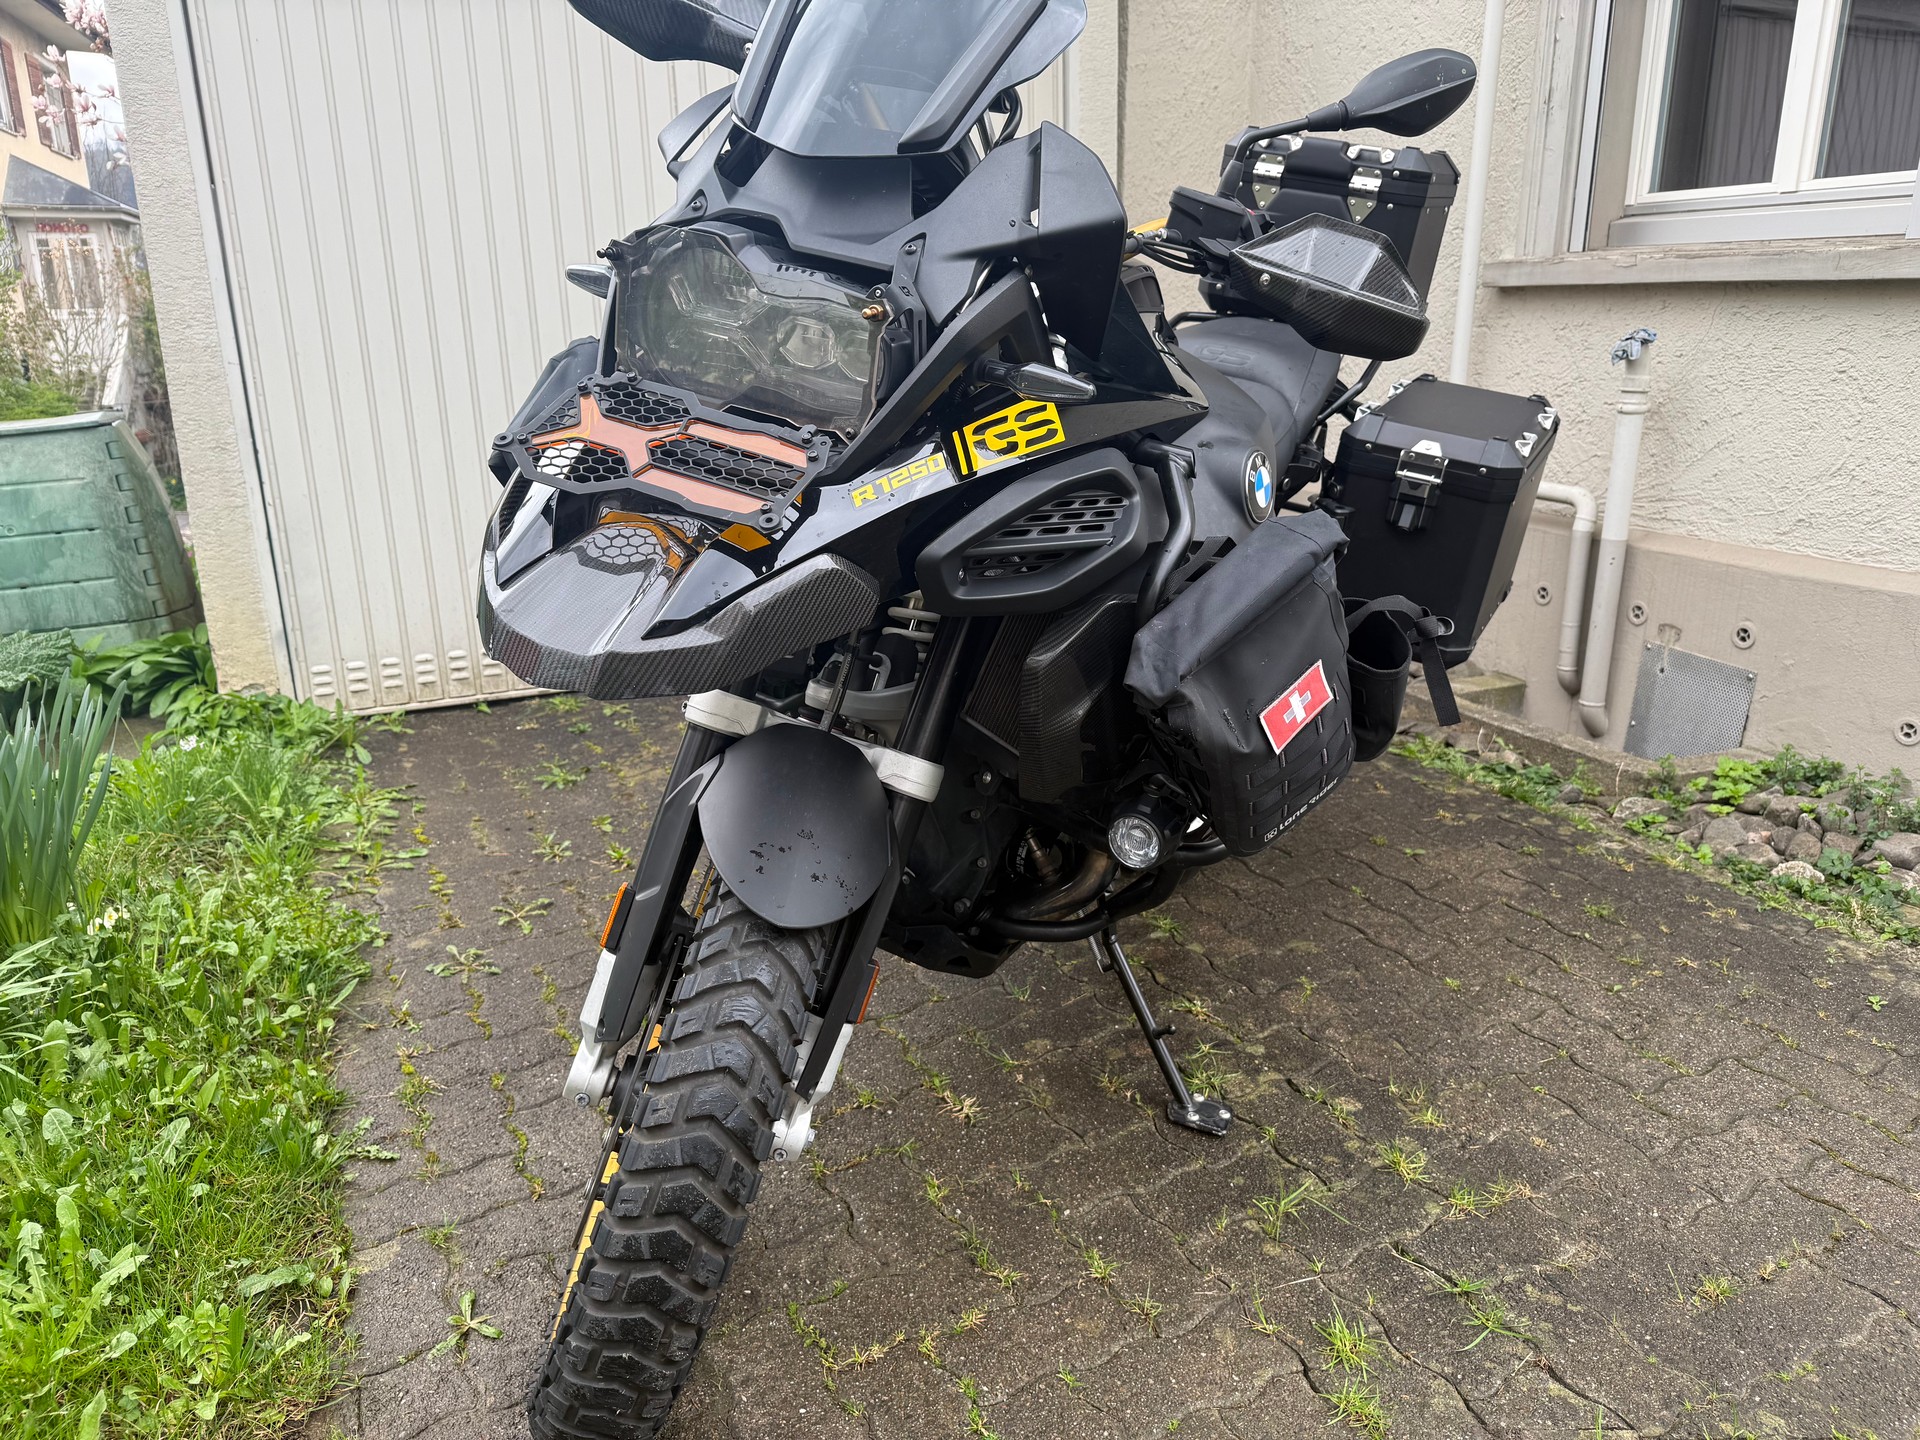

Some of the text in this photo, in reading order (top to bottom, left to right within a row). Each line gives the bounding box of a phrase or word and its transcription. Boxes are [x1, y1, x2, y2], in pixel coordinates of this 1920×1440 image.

[971, 403, 1060, 462] GS
[851, 452, 946, 508] R 1250
